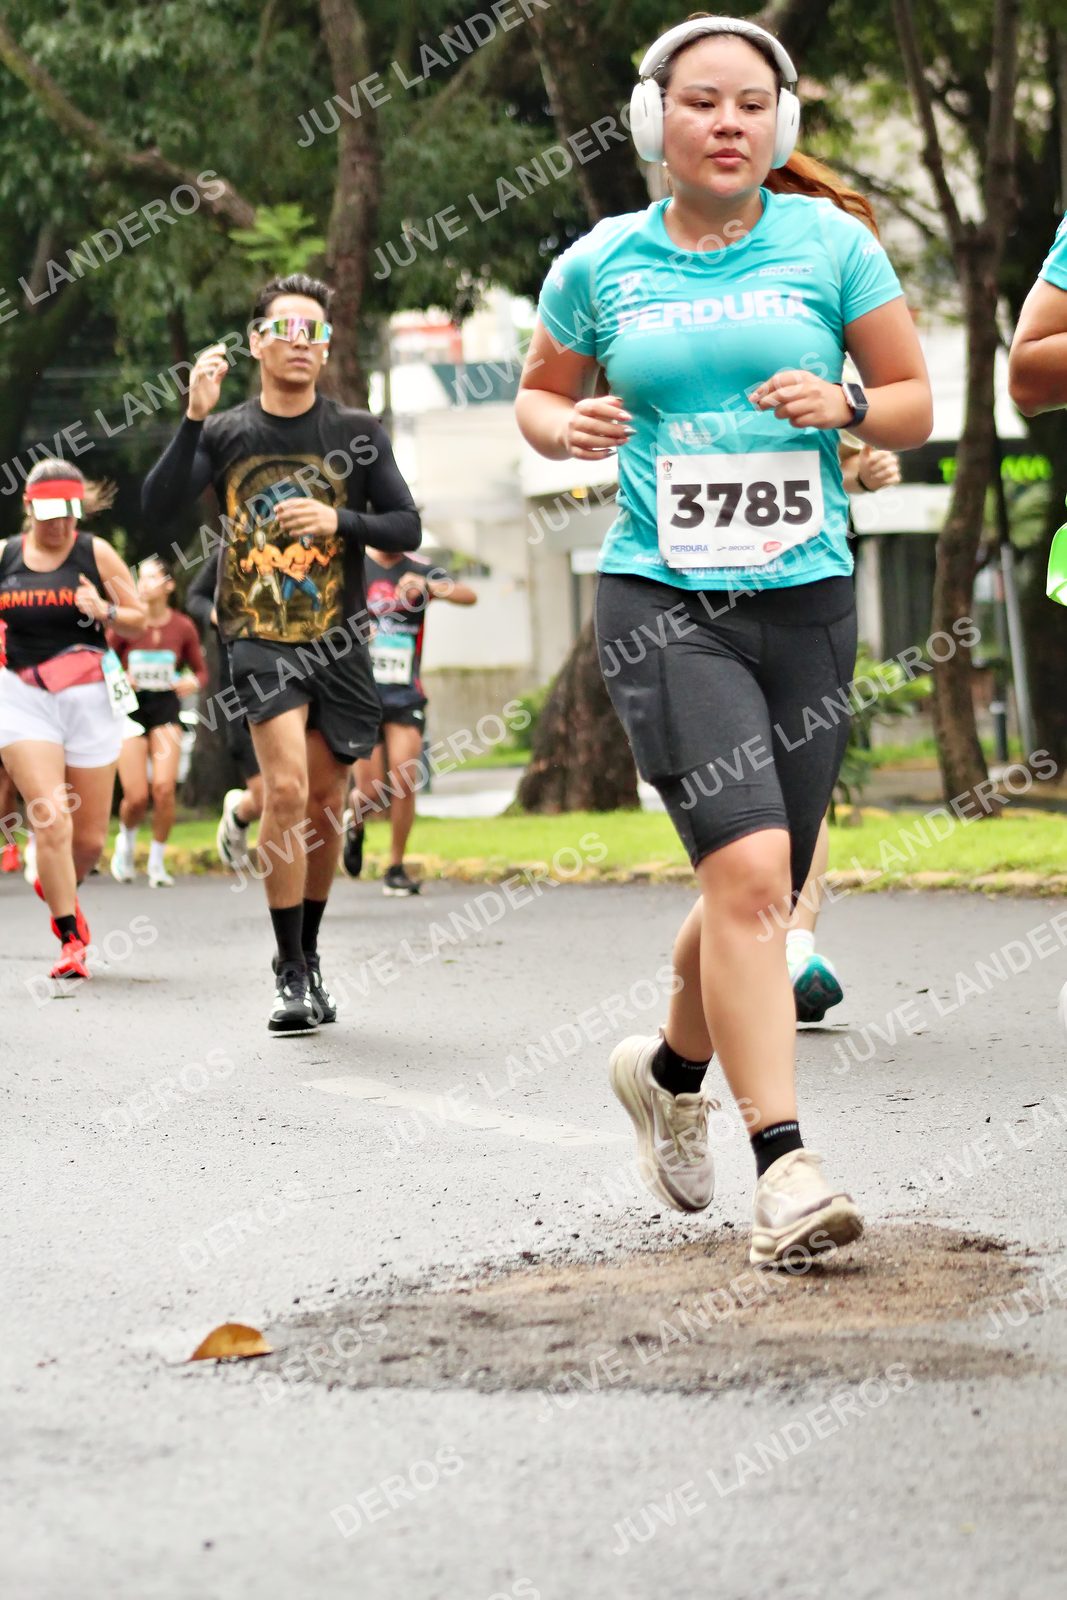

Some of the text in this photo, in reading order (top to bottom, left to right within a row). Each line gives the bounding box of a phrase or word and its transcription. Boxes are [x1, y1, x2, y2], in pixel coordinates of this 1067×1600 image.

[616, 289, 813, 335] PERDURA
[669, 480, 813, 529] 3785
[670, 544, 709, 552] PERDURA
[0, 586, 77, 610] RMITAÑ
